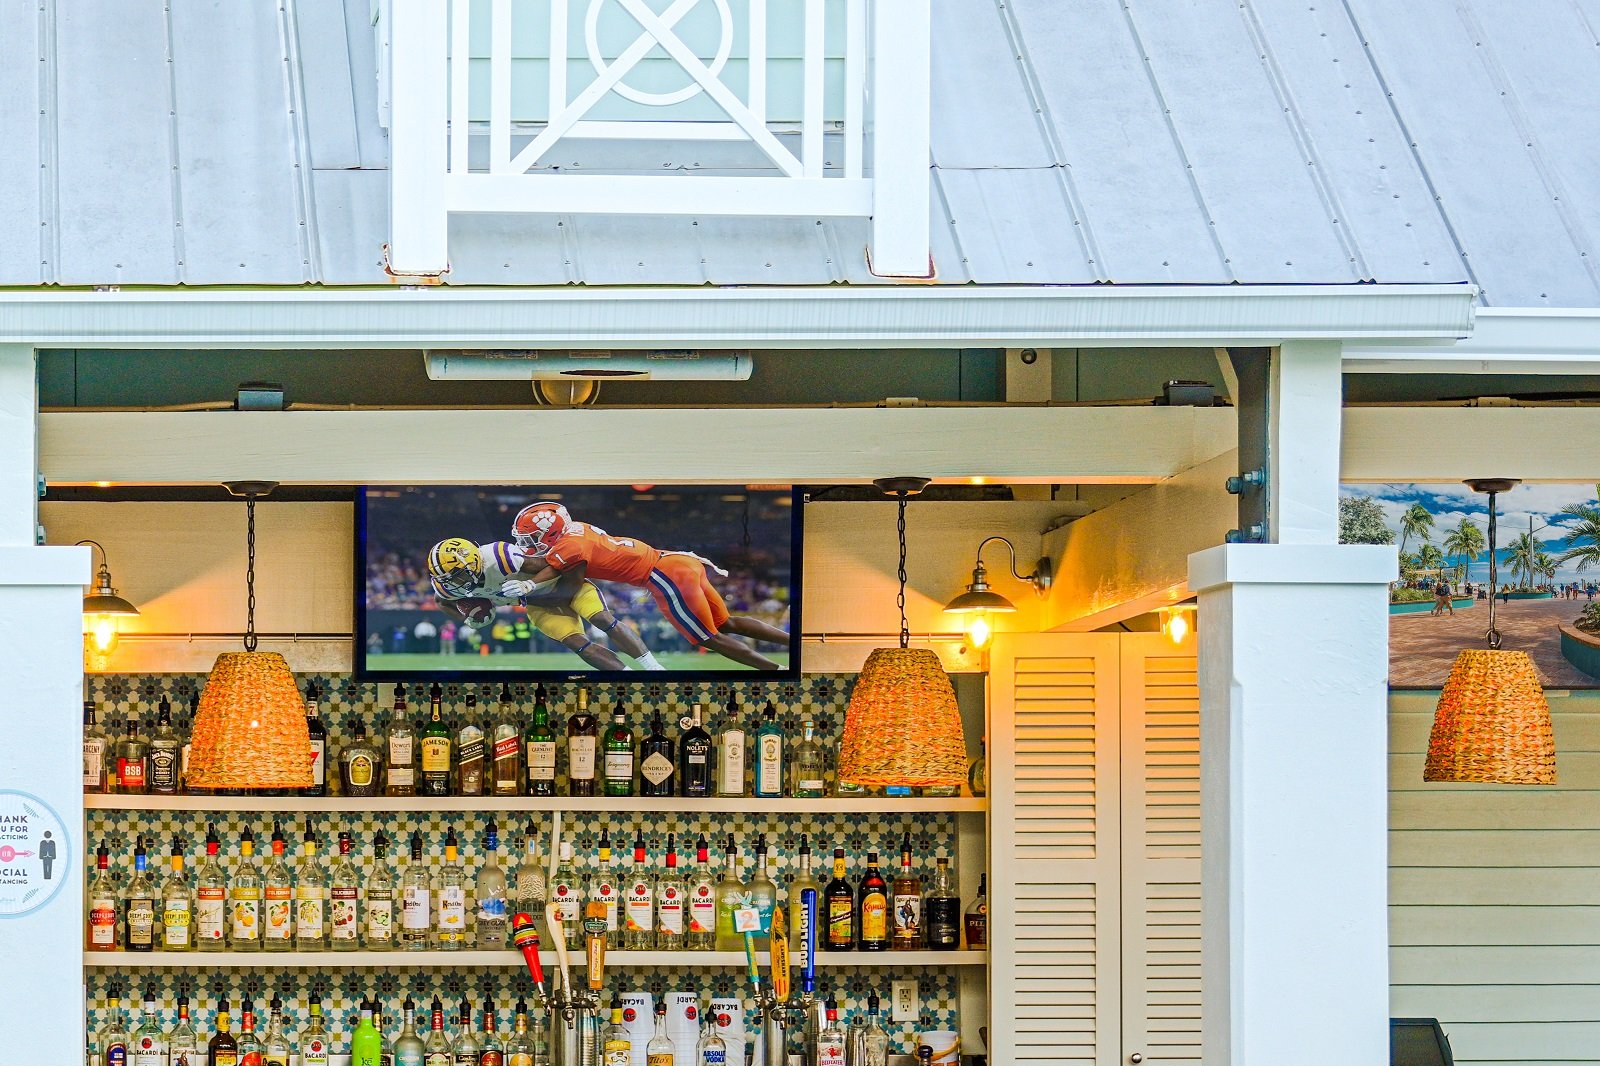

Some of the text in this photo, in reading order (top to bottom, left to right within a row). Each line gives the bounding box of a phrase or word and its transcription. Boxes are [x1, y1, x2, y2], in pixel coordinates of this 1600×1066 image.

[423, 738, 449, 747] JAMESON
[84, 745, 100, 754] ARCENY
[125, 766, 141, 776] BSB
[801, 903, 809, 939] LIGHT
[649, 1056, 668, 1064] Tito's
